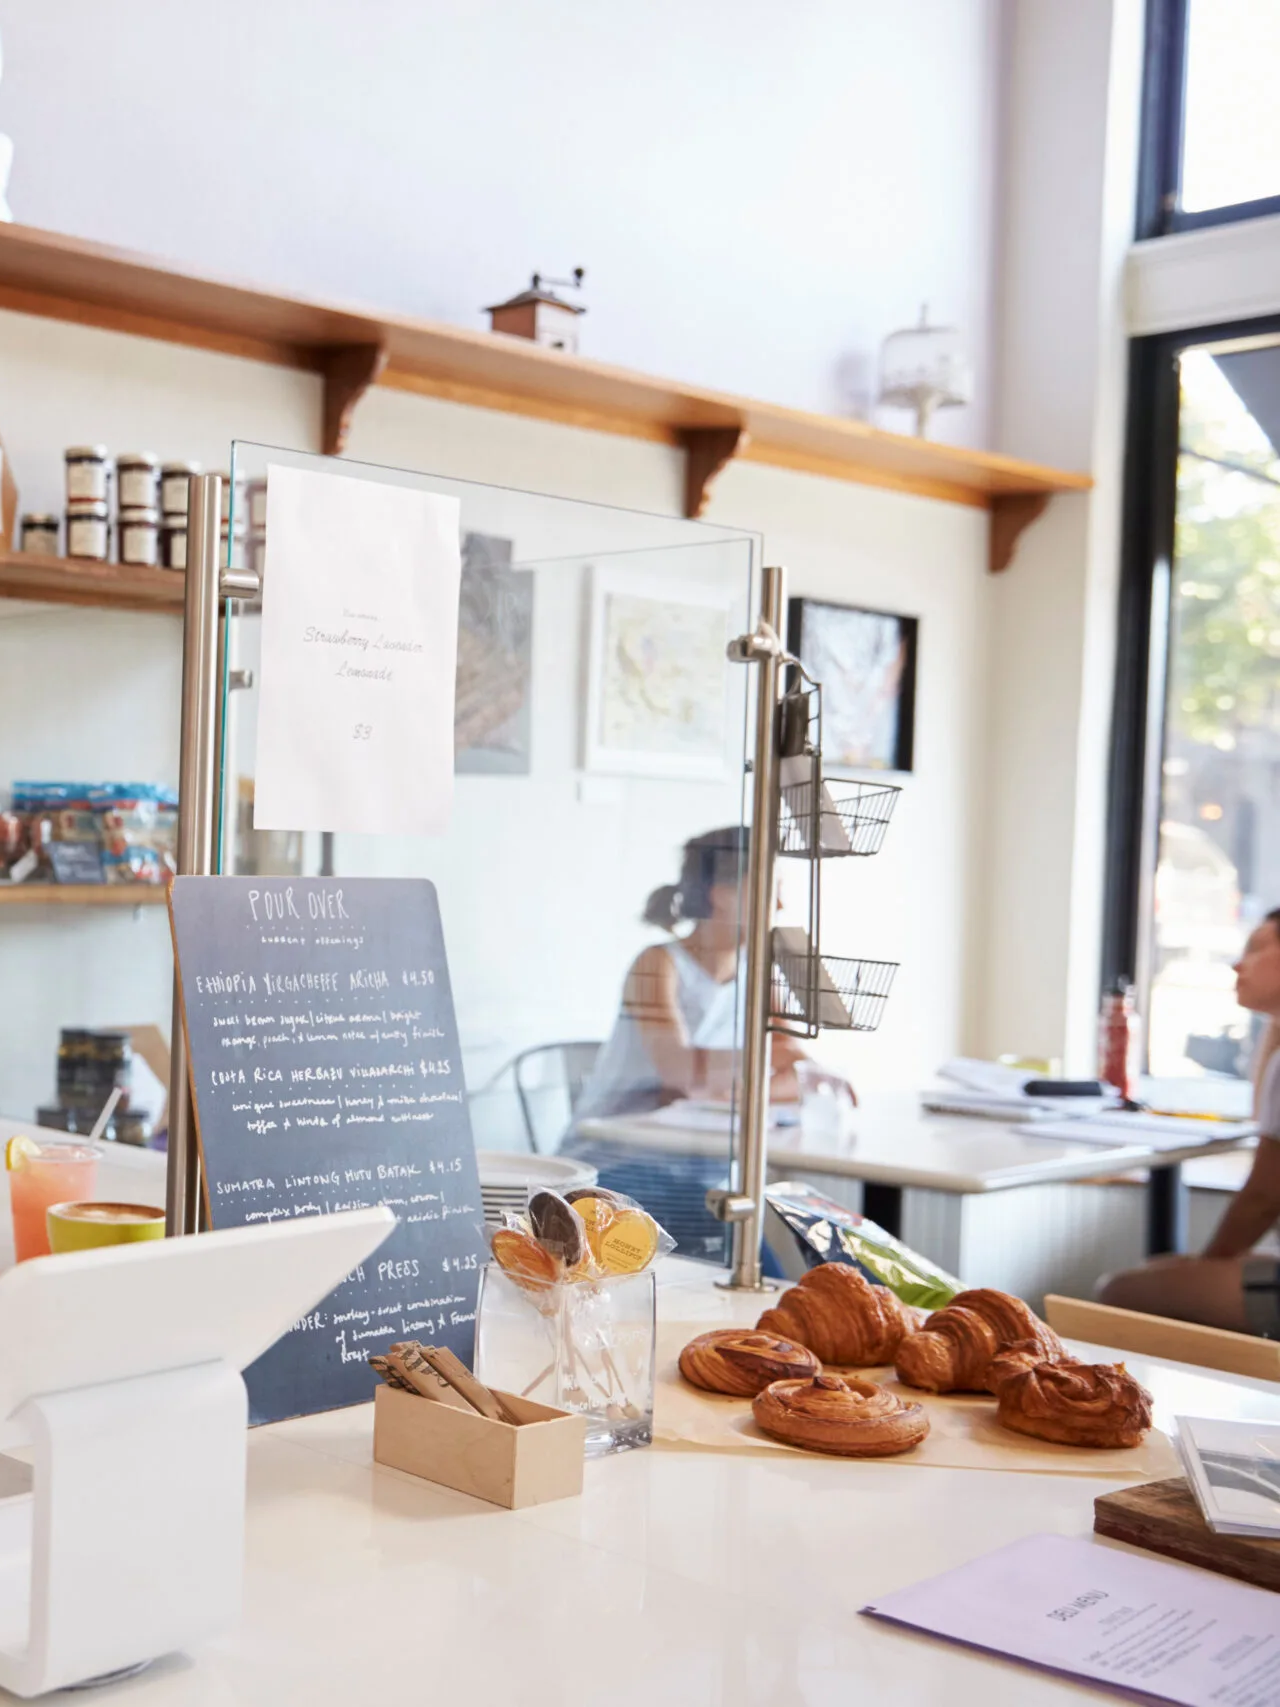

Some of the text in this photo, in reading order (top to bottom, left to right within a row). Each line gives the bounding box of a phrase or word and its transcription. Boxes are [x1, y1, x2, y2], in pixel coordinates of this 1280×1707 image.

[303, 626, 369, 650] Strawberry
[334, 660, 393, 681] Lemonade
[248, 886, 349, 921] POUR OVER
[216, 1178, 275, 1195] SUMATRA
[345, 1168, 372, 1183] MUTU
[377, 1162, 422, 1180] BATAK
[429, 1158, 462, 1174] $4.15
[612, 1238, 641, 1254] HONEY
[378, 1258, 420, 1281] PRESS
